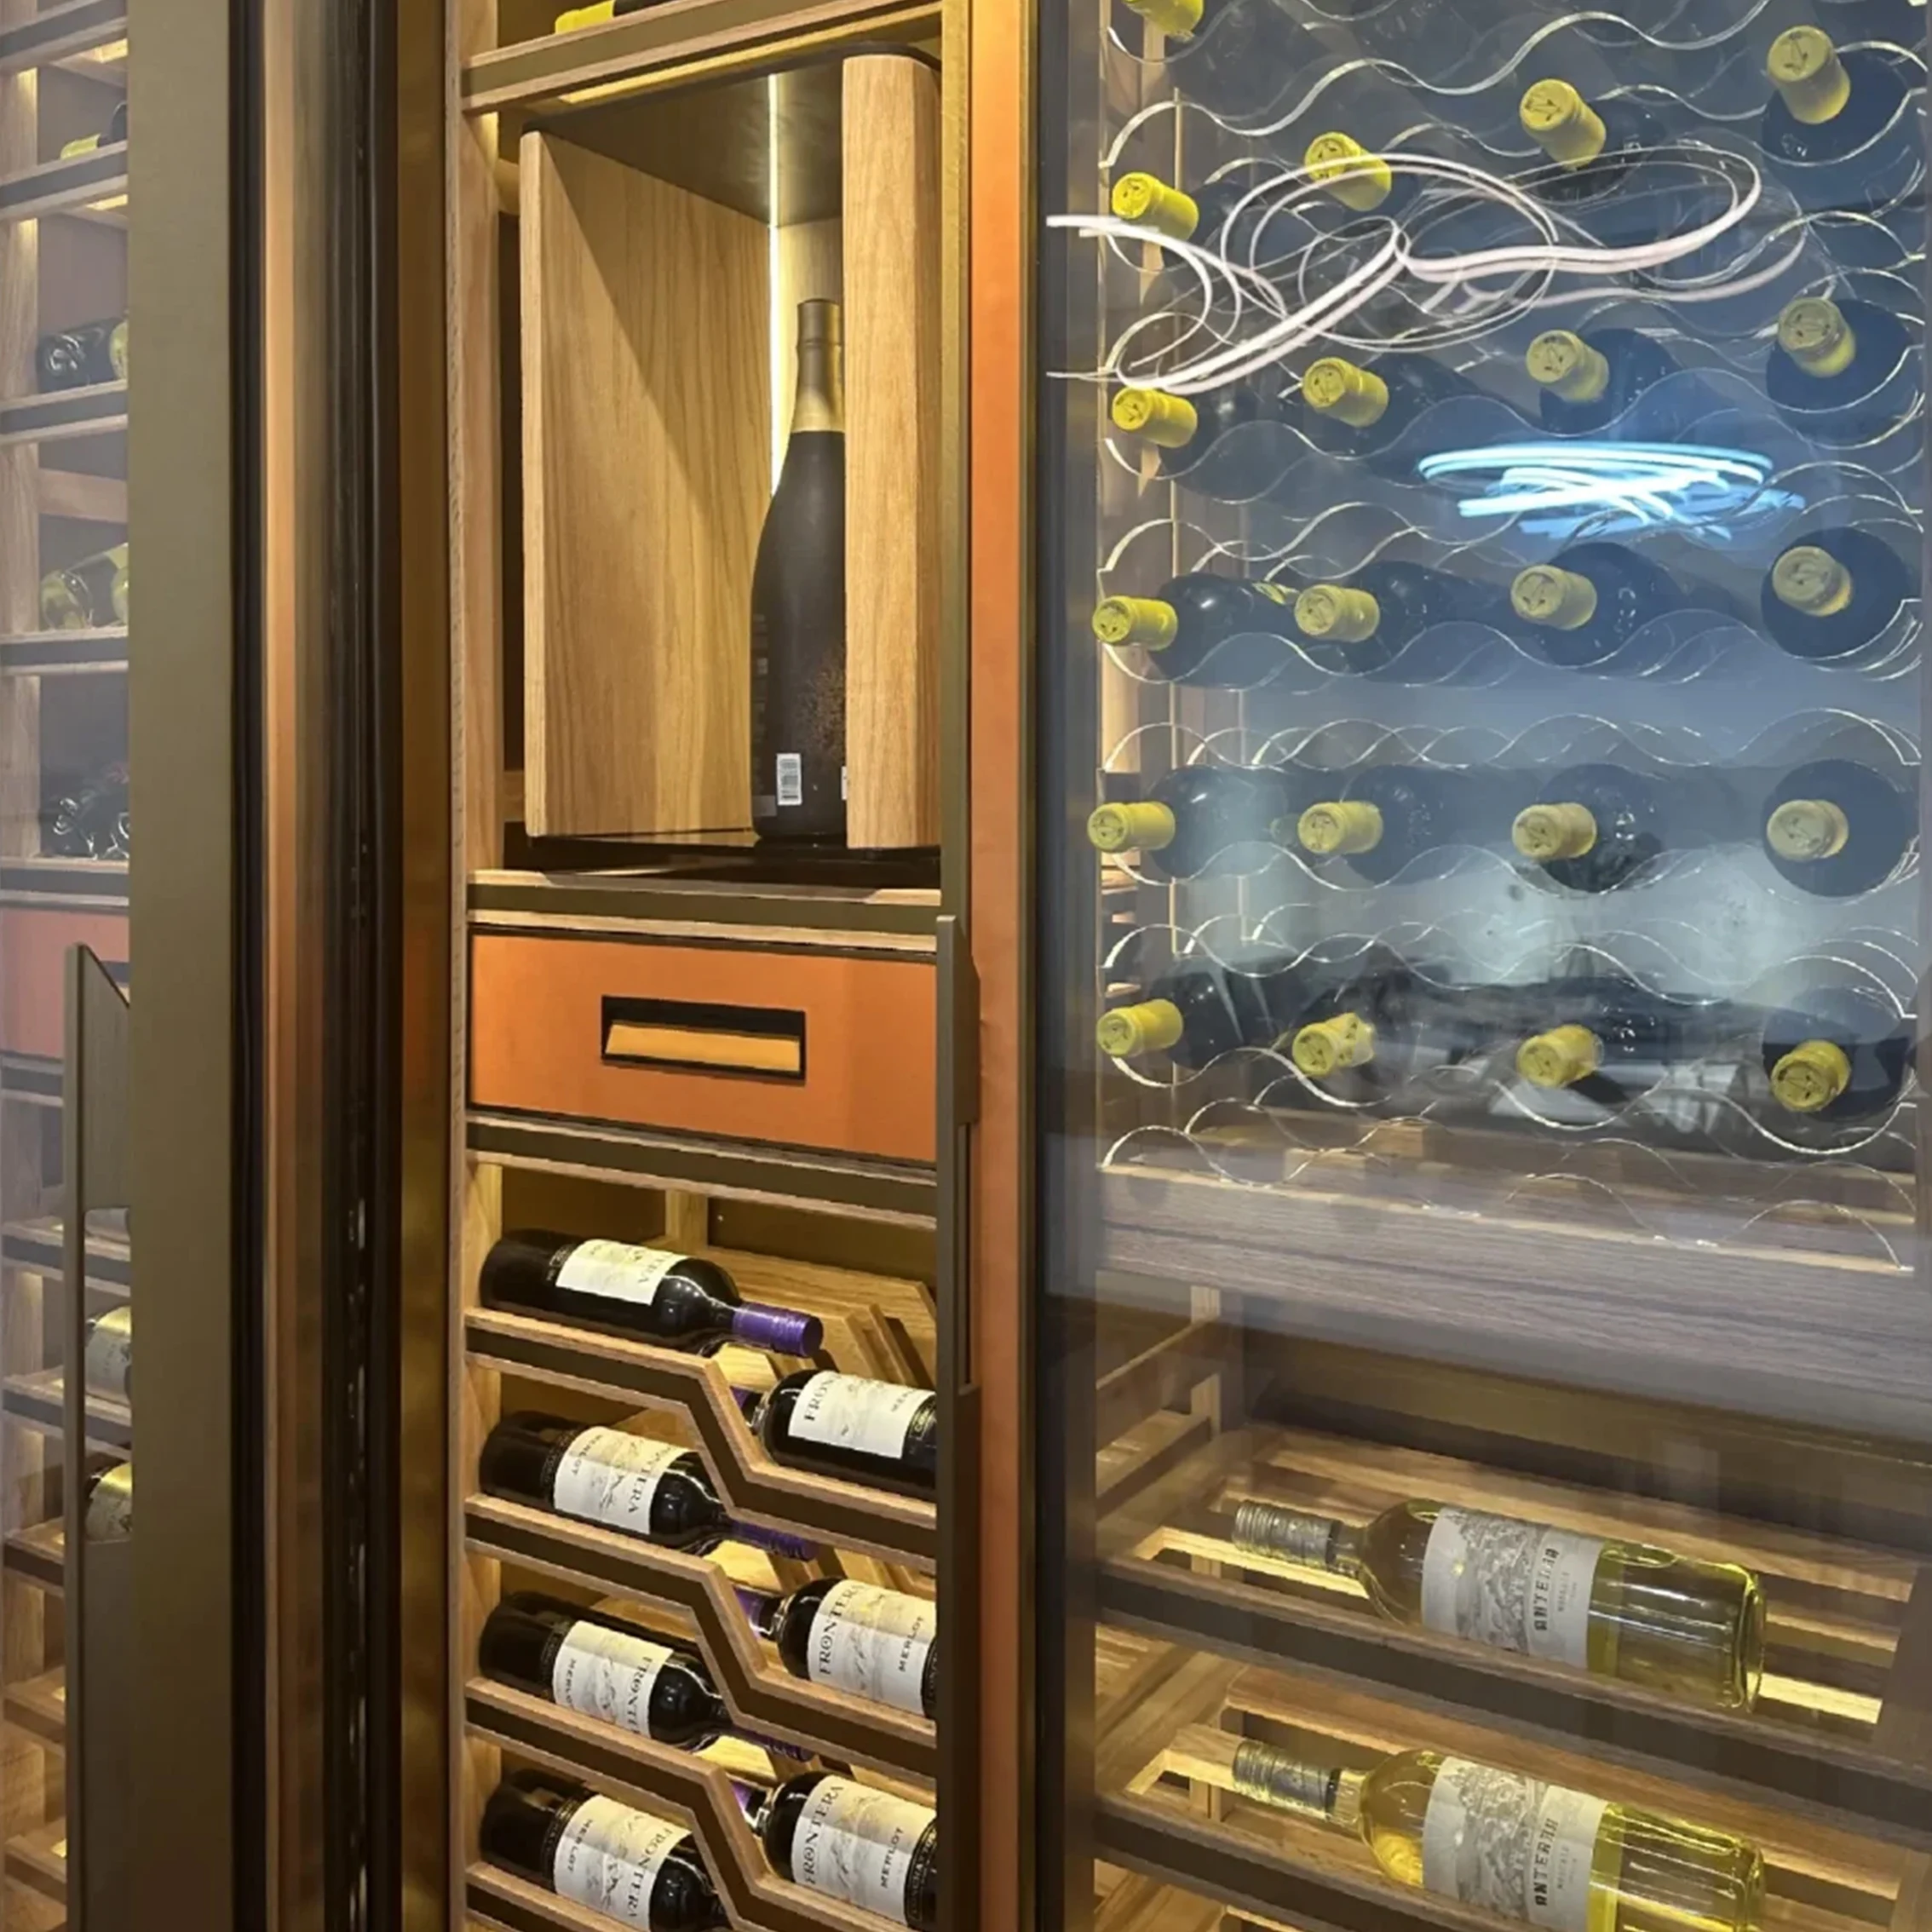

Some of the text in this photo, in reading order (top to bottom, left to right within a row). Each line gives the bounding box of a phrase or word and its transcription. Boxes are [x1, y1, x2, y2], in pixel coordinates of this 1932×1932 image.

[898, 1615, 925, 1673] MERLOT
[565, 1658, 578, 1705] MERLO
[627, 1656, 653, 1734] FRONTE
[567, 1819, 594, 1872] MERLOT
[802, 1785, 844, 1885] FRONTERA
[880, 1826, 905, 1889] MERLOT
[628, 1826, 673, 1918] FRONTERA
